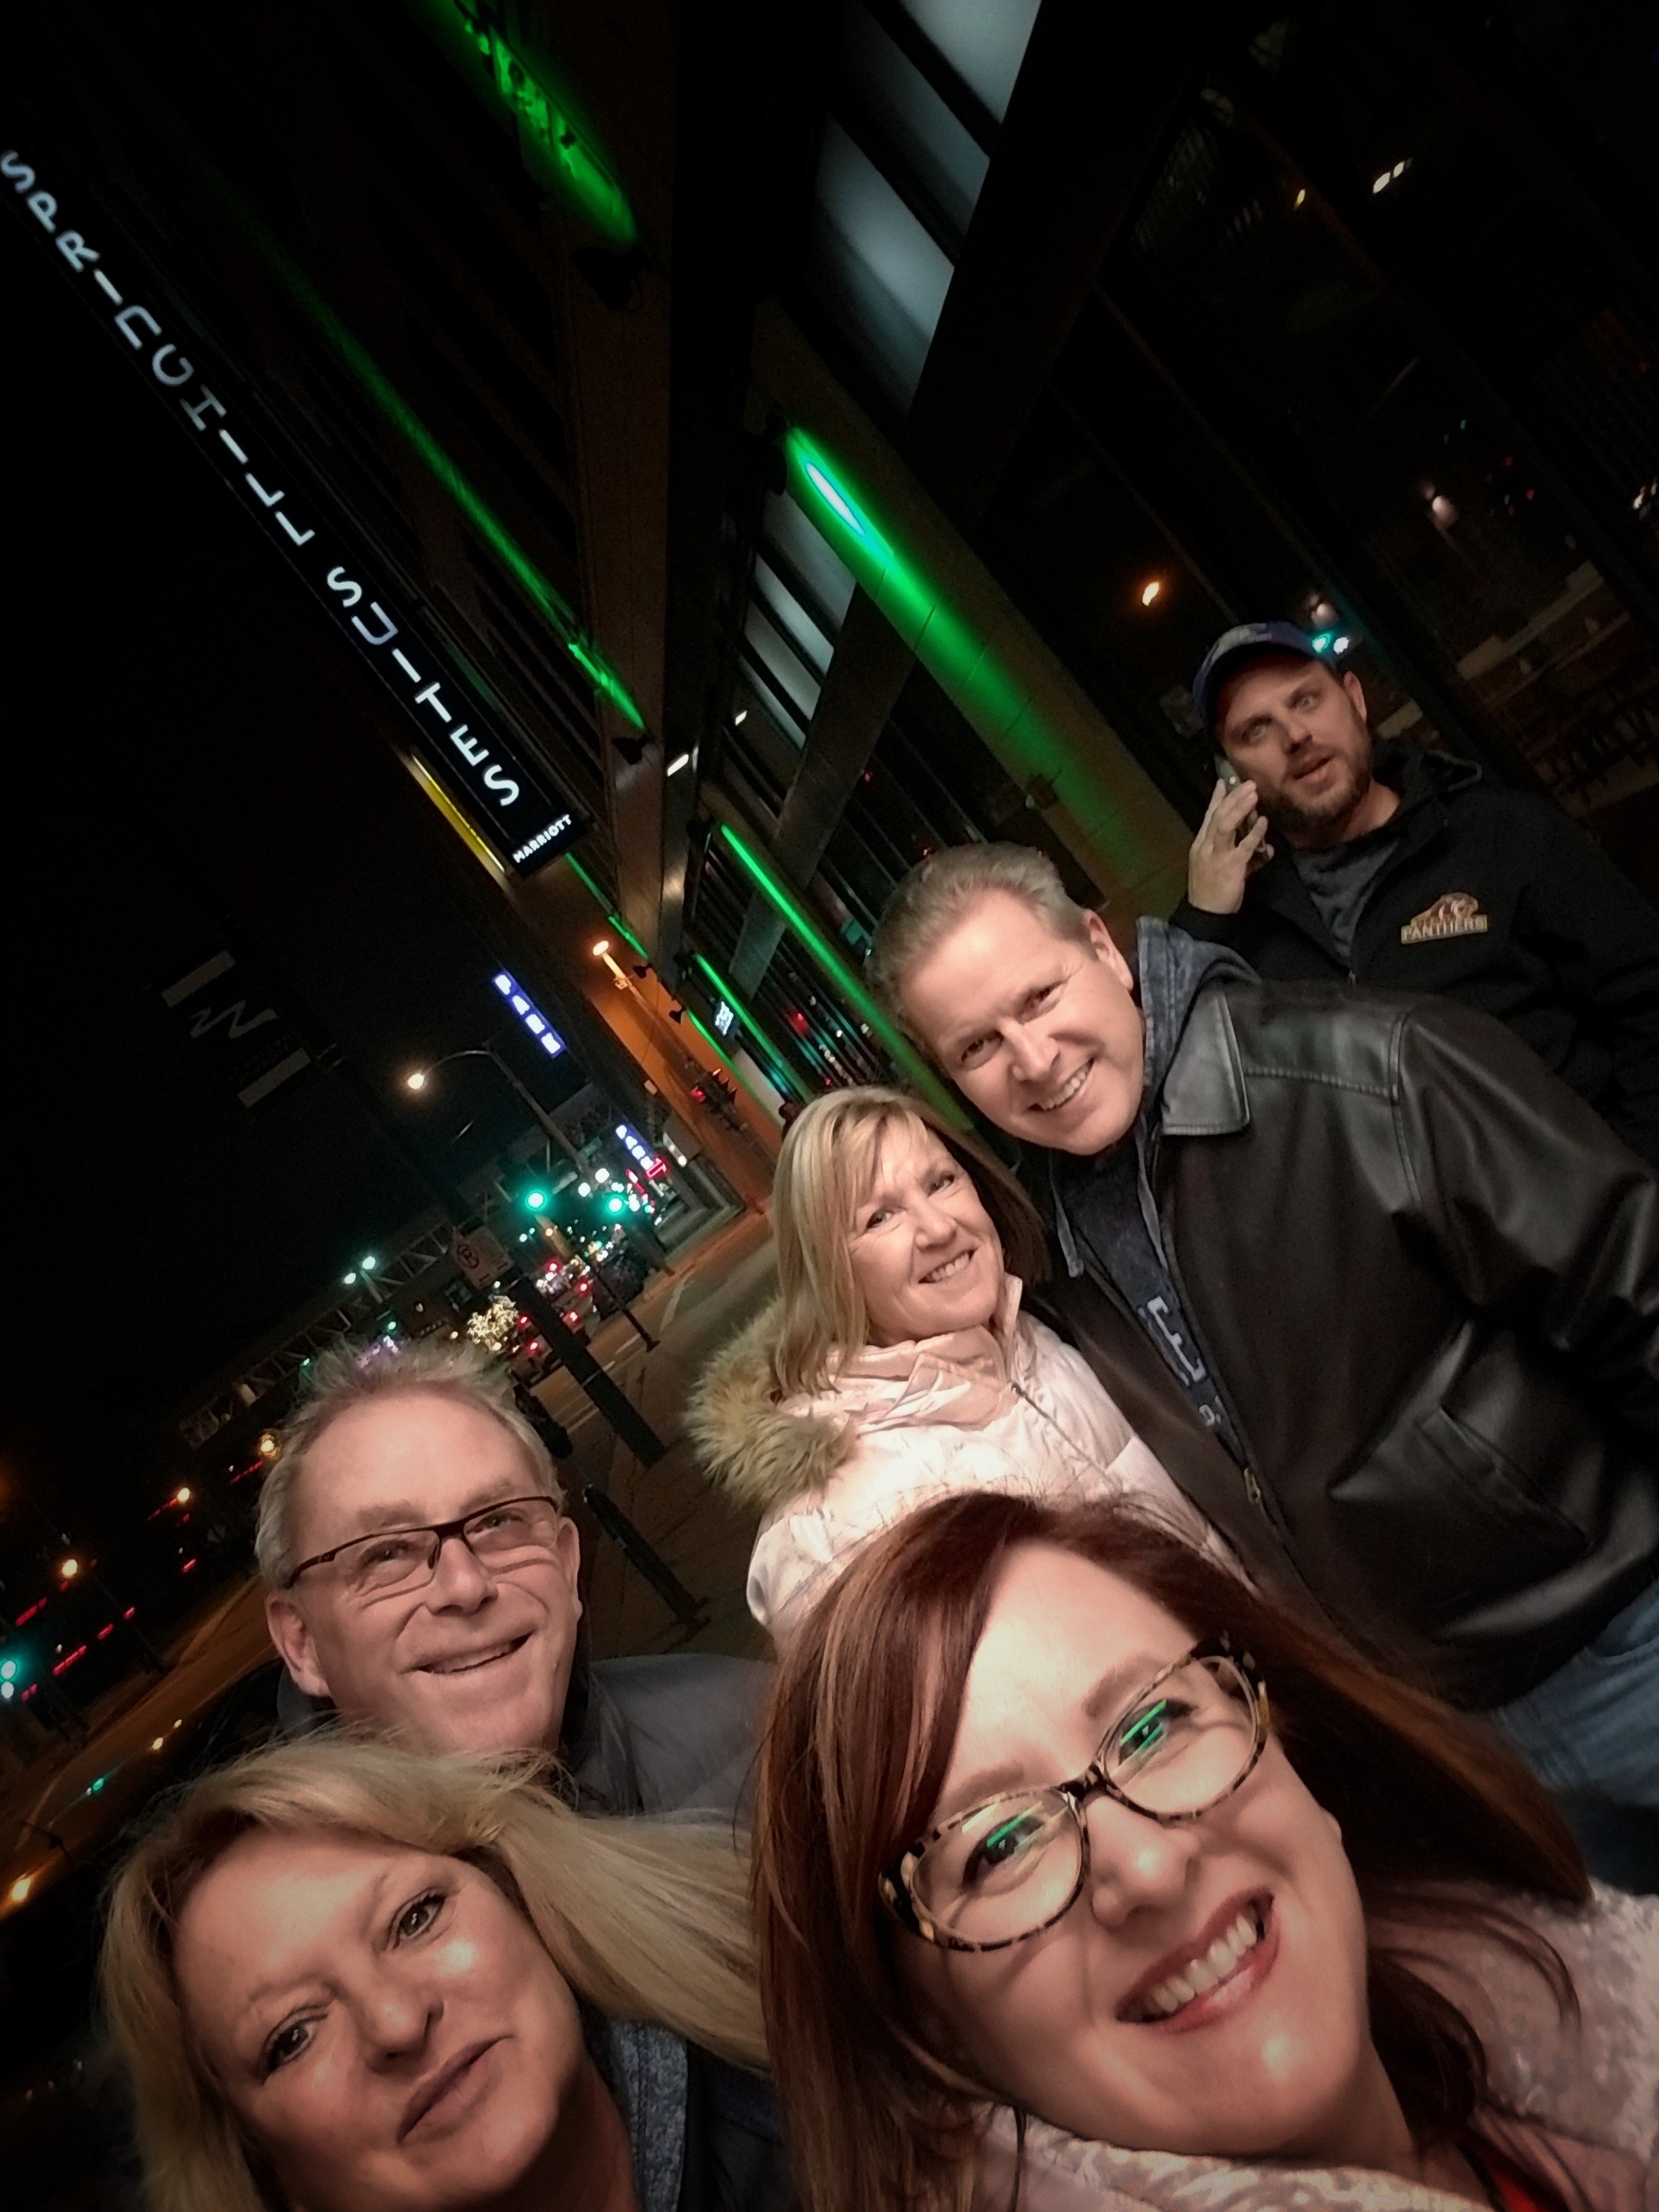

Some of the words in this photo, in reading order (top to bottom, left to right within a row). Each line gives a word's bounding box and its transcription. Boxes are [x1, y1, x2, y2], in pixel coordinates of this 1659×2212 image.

[0, 150, 316, 547] SPRINGHILL
[327, 566, 520, 807] SUITES
[512, 814, 572, 863] MARRIOTT
[1403, 916, 1485, 941] PANTHERS
